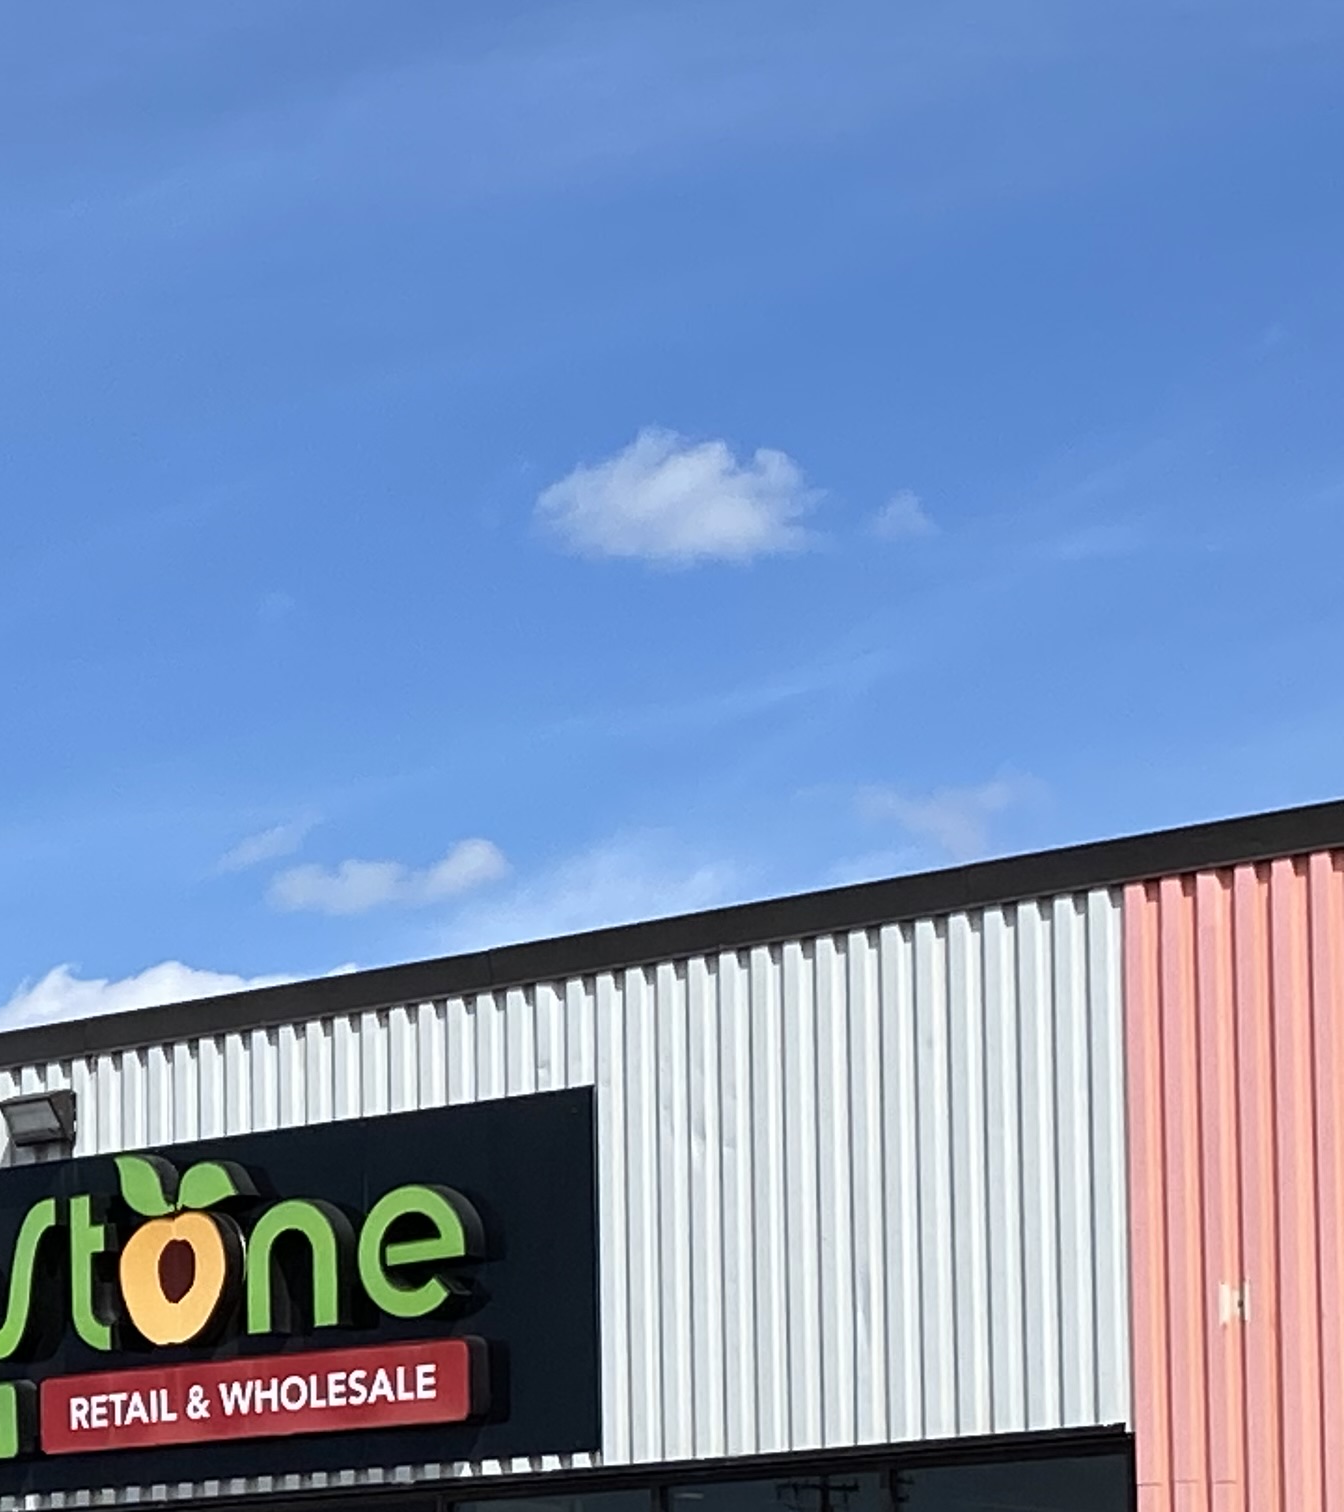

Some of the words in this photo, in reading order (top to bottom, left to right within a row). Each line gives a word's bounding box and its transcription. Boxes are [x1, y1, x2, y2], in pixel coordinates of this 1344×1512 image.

[69, 1387, 178, 1431] RETAIL
[185, 1384, 211, 1420] &
[218, 1363, 438, 1416] WHOLESALE
